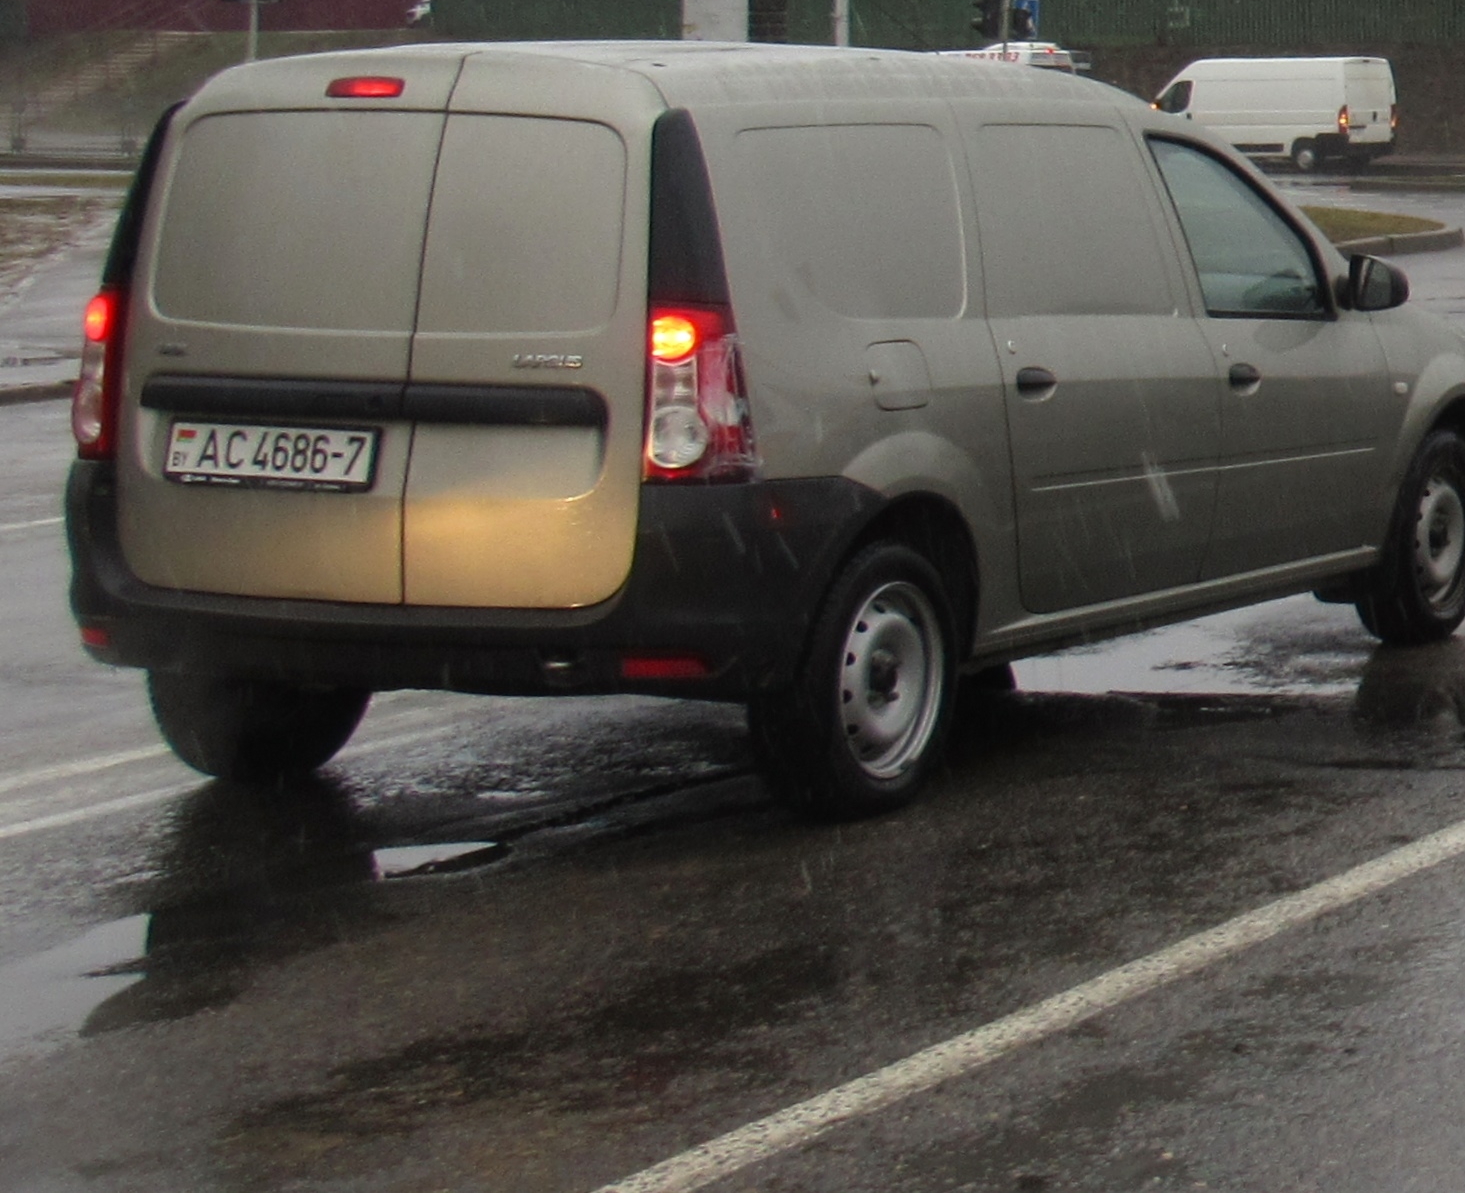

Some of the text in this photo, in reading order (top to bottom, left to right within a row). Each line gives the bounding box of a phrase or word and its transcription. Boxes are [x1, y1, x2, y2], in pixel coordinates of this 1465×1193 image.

[172, 450, 188, 467] BY
[196, 428, 367, 476] AC 4686-7
